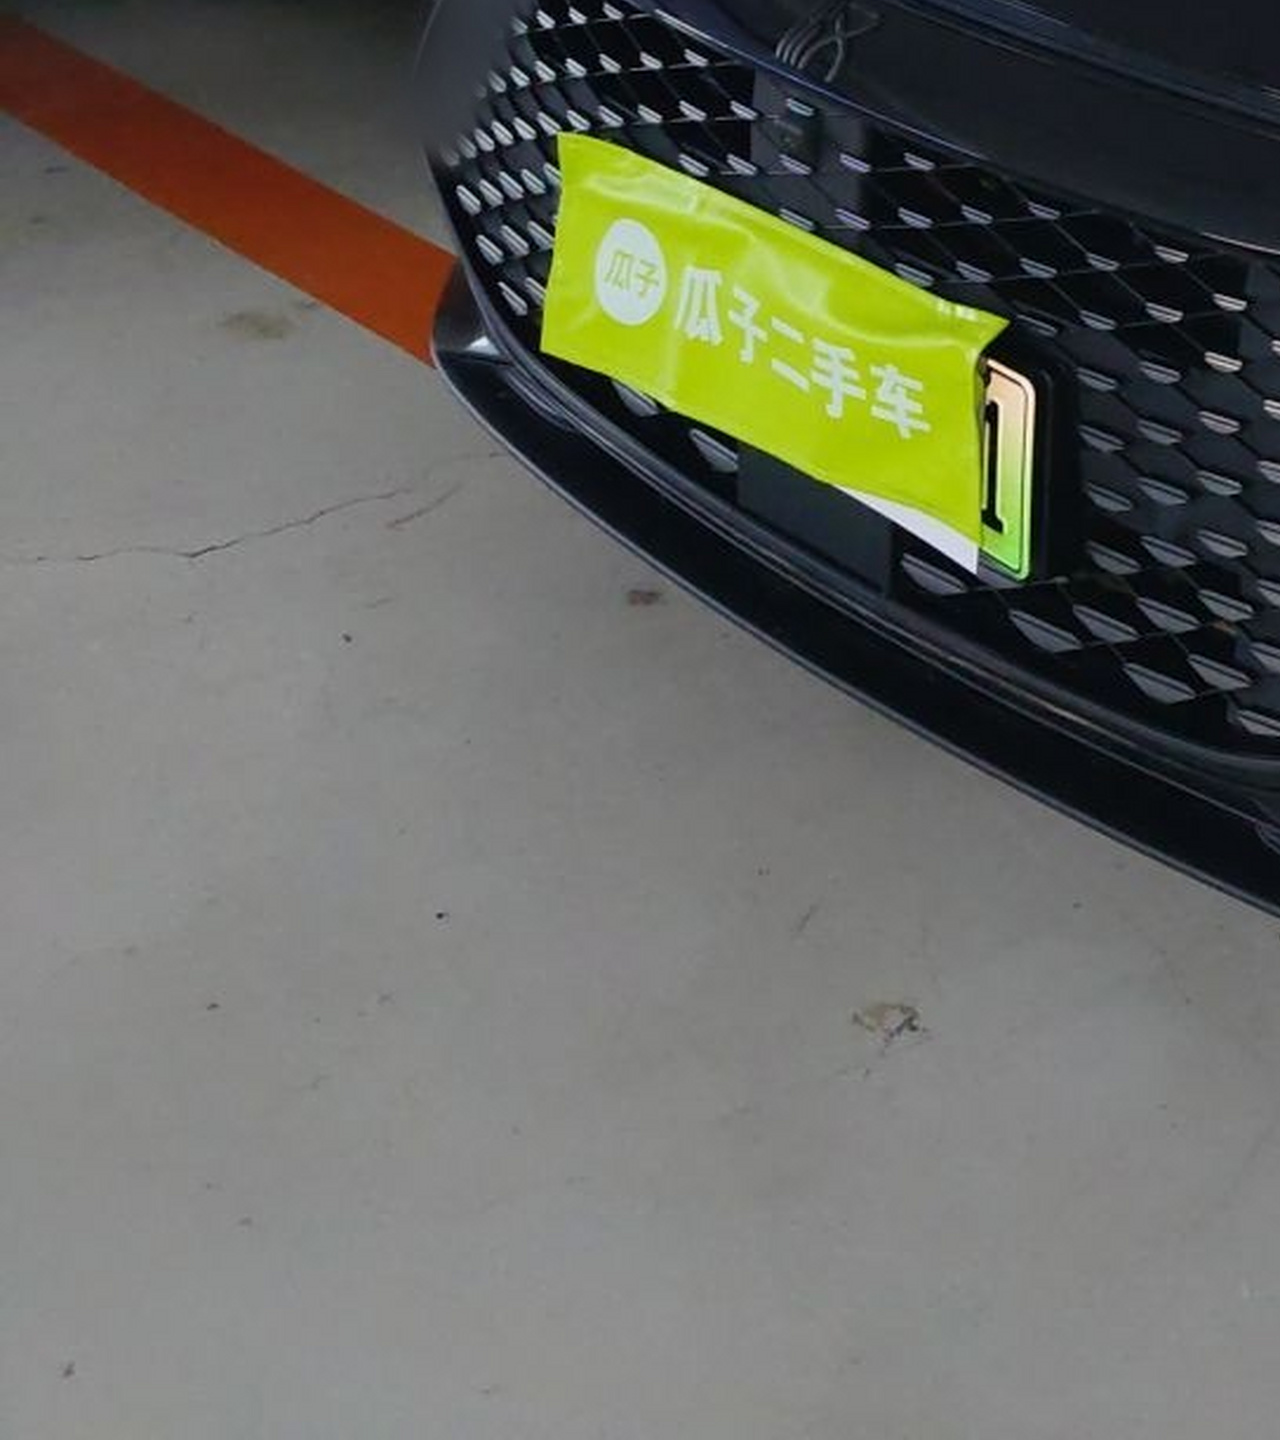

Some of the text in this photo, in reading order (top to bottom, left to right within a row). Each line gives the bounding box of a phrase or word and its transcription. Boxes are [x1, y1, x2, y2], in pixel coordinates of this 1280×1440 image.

[604, 248, 934, 440] 瓜子 瓜子二手车
